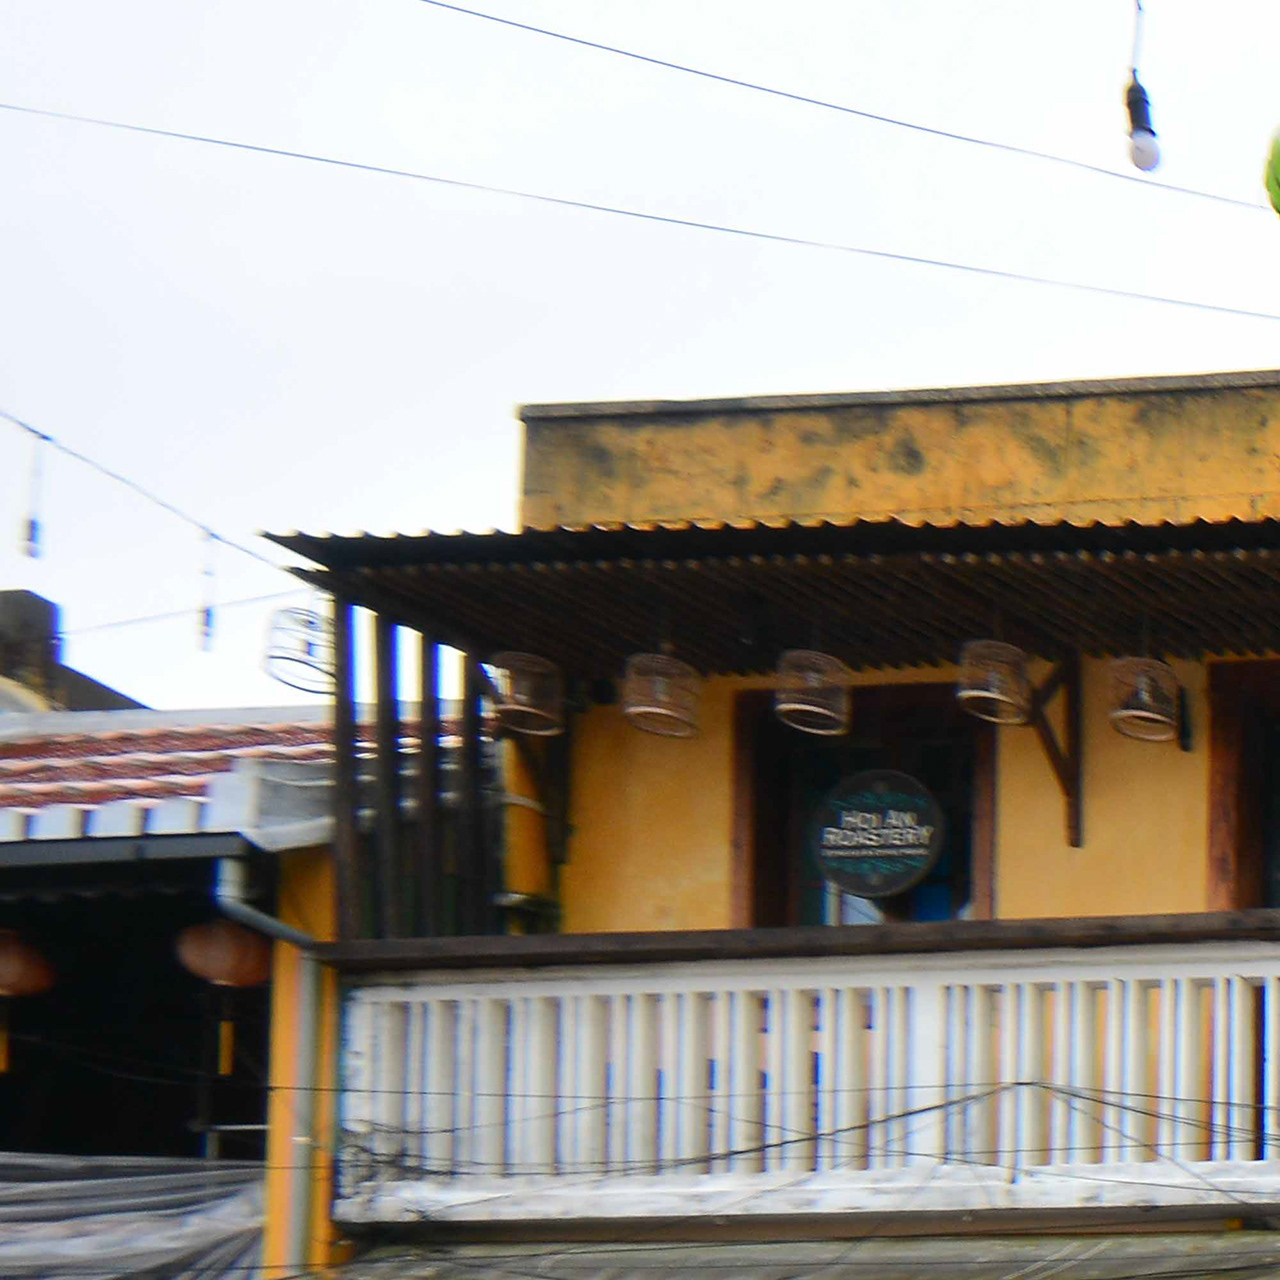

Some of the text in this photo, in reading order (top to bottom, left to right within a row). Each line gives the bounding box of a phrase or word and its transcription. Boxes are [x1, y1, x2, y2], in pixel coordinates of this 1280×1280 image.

[841, 809, 918, 829] HOI AN
[821, 825, 934, 847] ROASTERY
